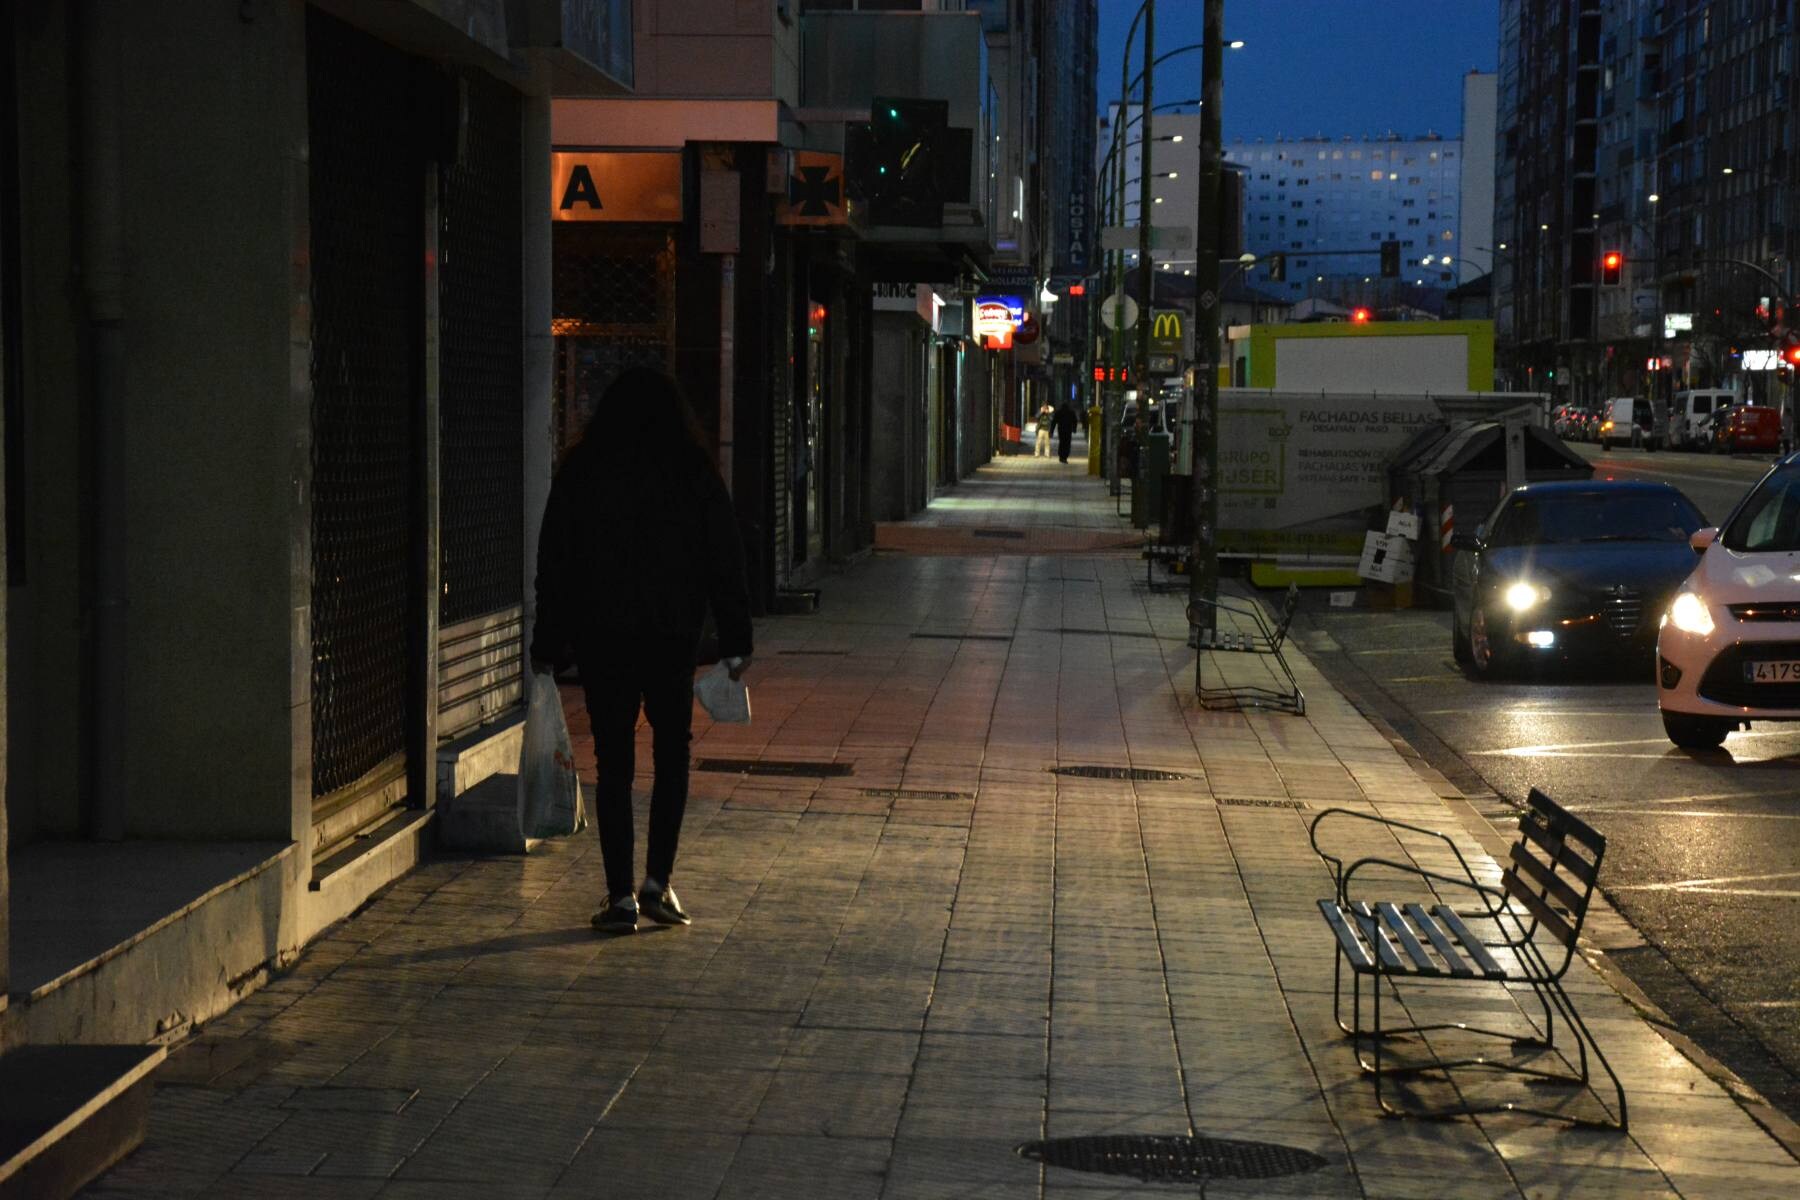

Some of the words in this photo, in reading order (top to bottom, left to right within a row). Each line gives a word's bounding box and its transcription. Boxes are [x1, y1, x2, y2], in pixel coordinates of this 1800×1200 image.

[1069, 193, 1084, 264] HOSTAL
[1300, 410, 1378, 424] FACHADAS
[1383, 411, 1434, 424] BELLAS
[1217, 451, 1271, 464] GRUPO
[1299, 462, 1359, 472] FACHADAS
